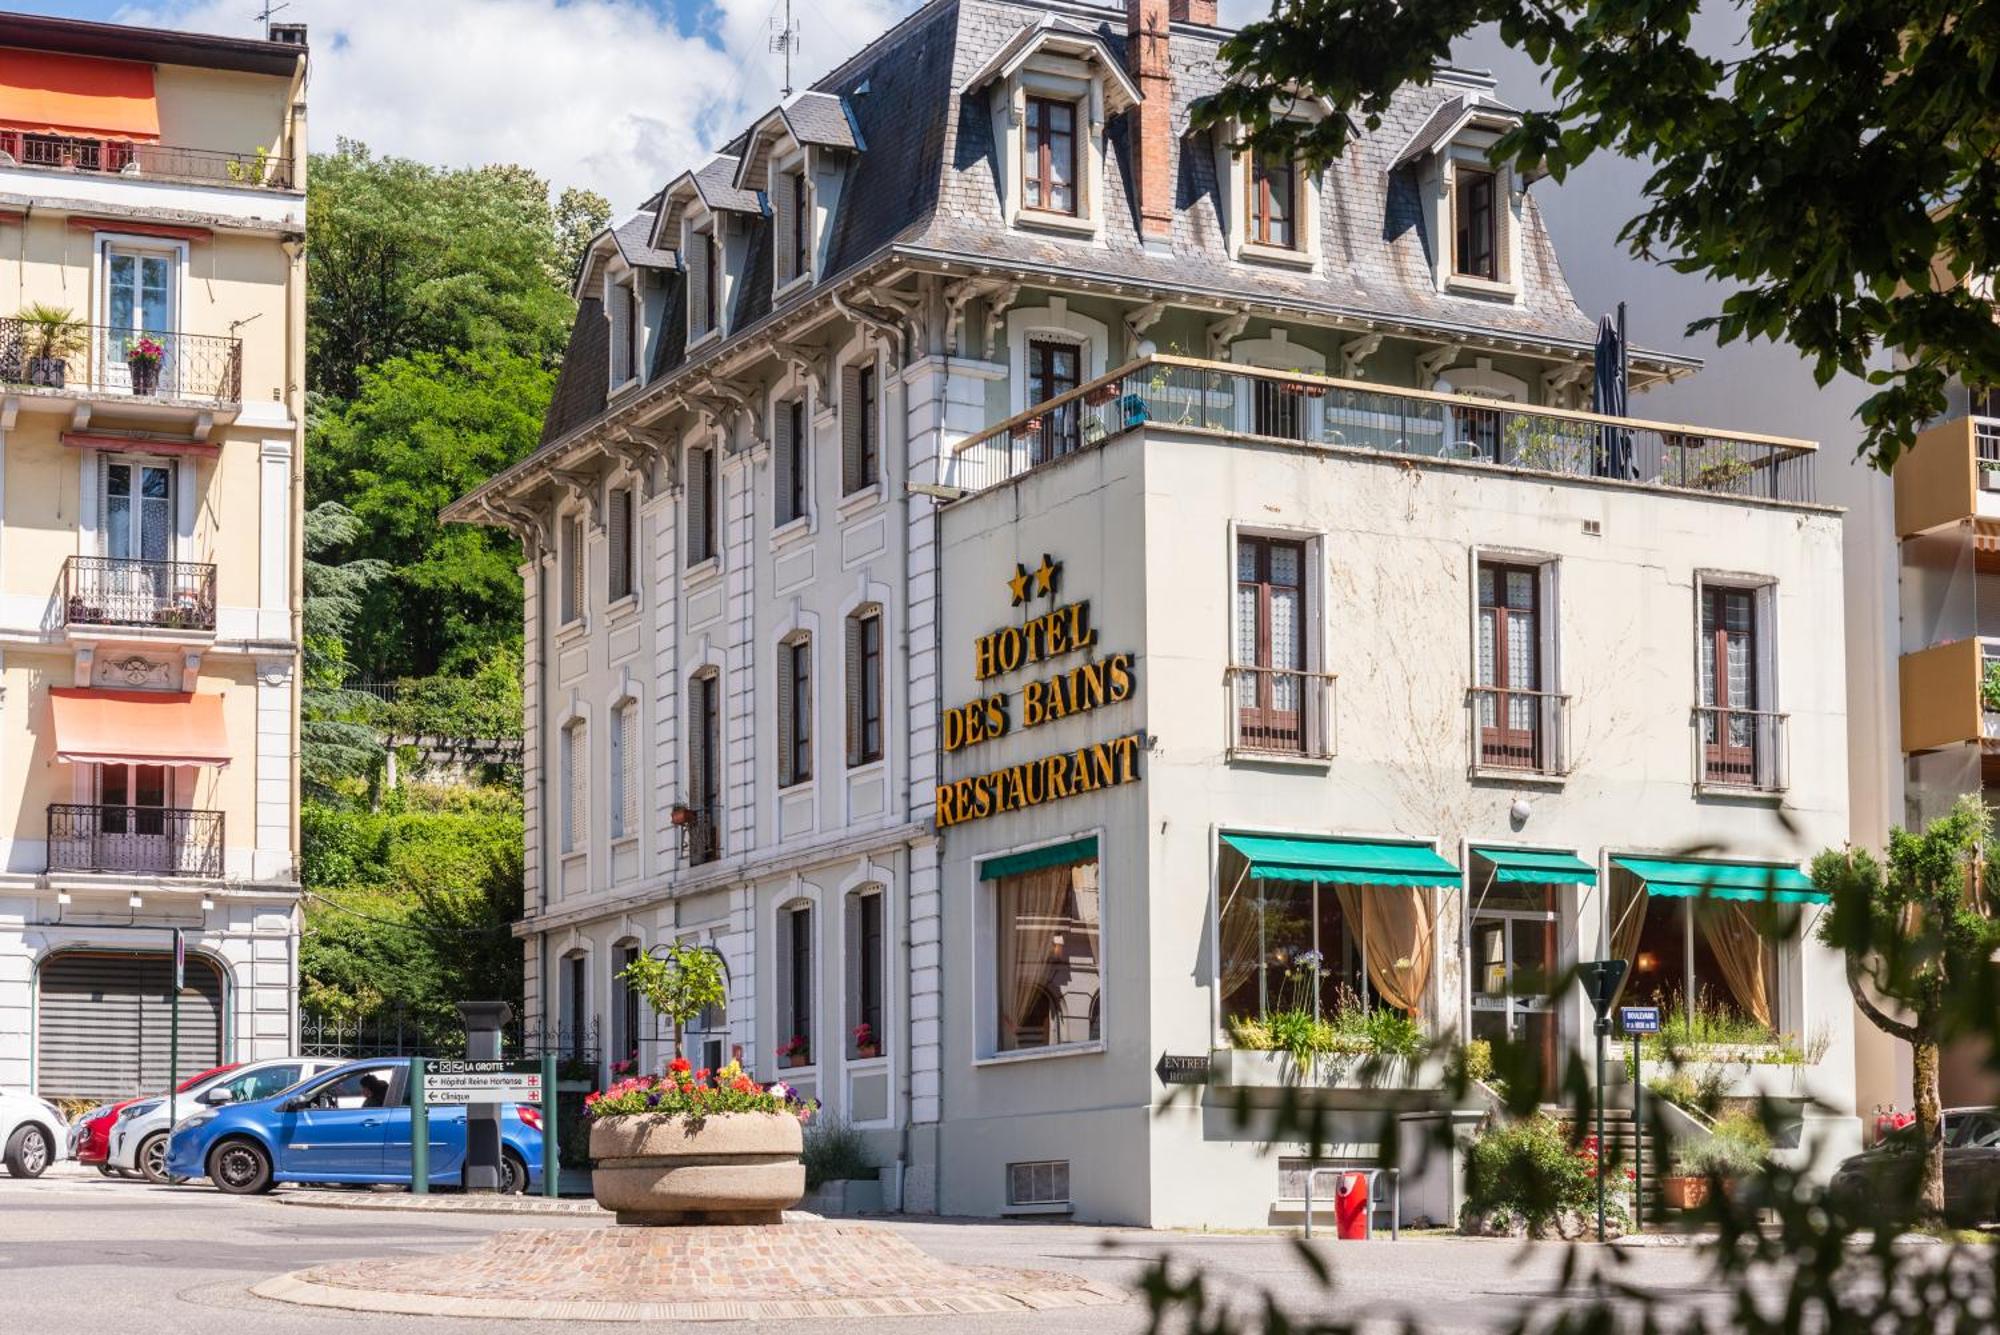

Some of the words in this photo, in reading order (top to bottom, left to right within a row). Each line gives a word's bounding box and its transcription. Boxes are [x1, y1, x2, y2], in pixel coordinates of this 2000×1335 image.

[975, 600, 1098, 681] HOTEL
[943, 692, 1009, 752] DES
[1023, 653, 1135, 728] BAINS
[935, 733, 1141, 829] RESTAURANT
[440, 1092, 470, 1101] Clinique
[465, 1062, 473, 1071] LA
[475, 1062, 504, 1071] GROTTE
